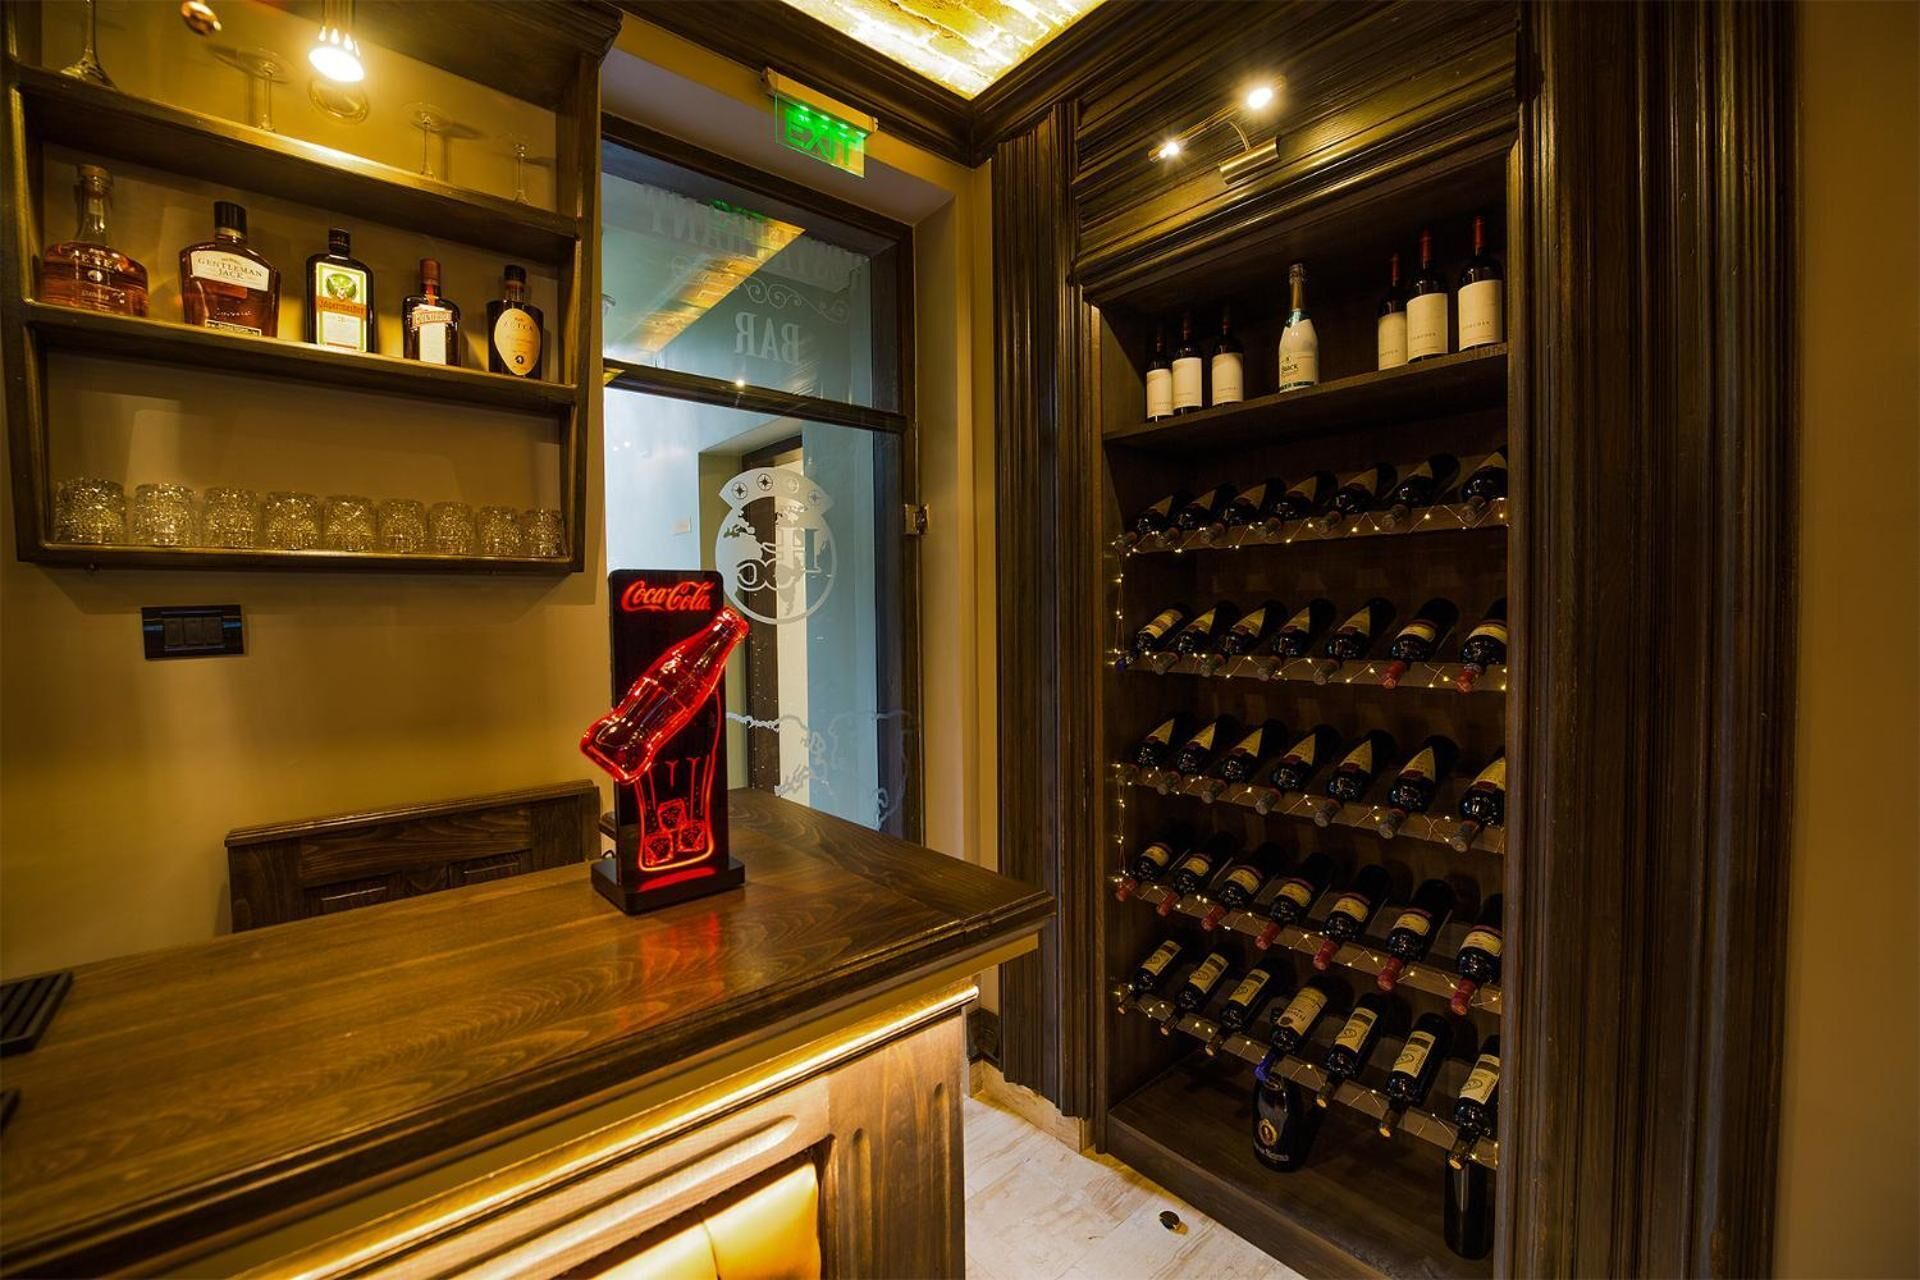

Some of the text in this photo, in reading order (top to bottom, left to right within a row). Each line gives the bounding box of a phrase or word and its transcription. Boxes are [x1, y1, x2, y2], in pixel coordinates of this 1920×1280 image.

[784, 109, 860, 166] EXIT
[197, 257, 263, 277] GENTLEMAN
[219, 268, 244, 280] JACK
[621, 580, 716, 612] Coca-Cola
